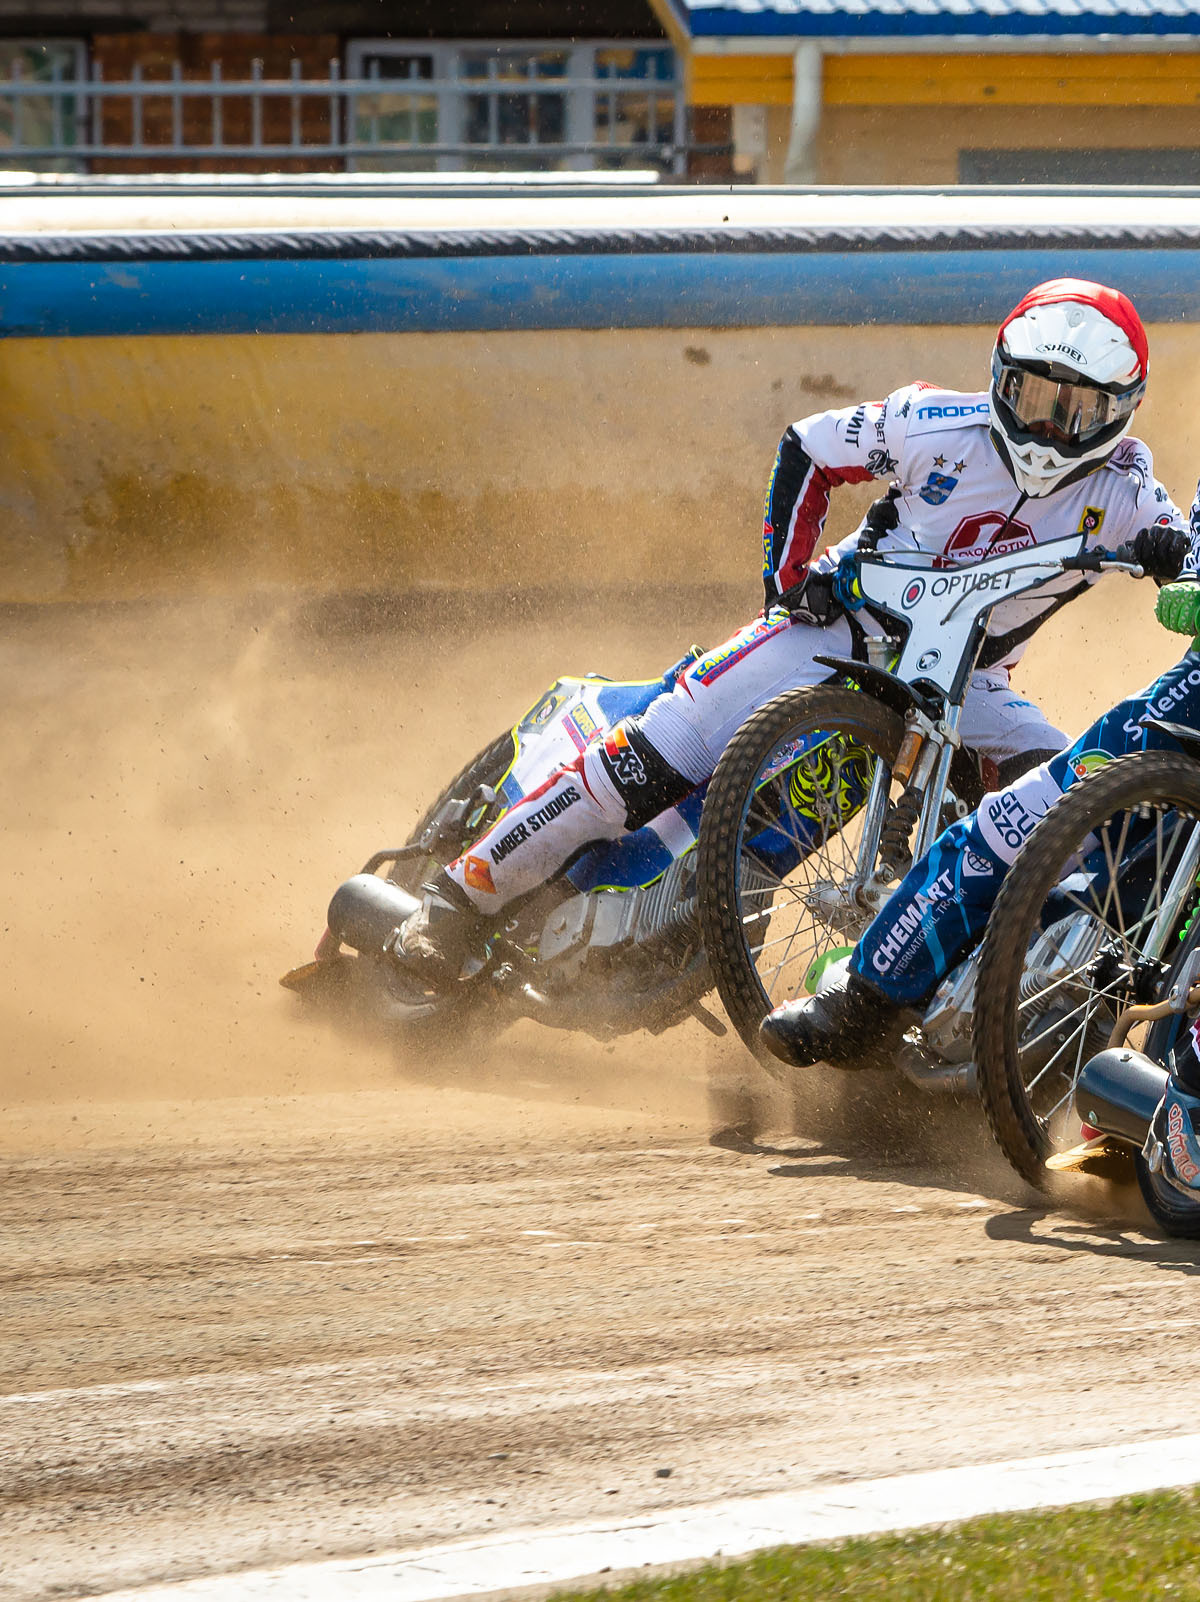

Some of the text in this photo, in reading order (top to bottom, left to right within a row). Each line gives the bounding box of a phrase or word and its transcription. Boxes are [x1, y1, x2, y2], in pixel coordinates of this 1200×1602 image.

[1044, 343, 1082, 364] SHOEI
[931, 570, 1016, 597] OPTIBET
[490, 785, 582, 865] AMBER STUDIOS
[988, 800, 1023, 849] AZO
[872, 868, 954, 973] CHEMART
